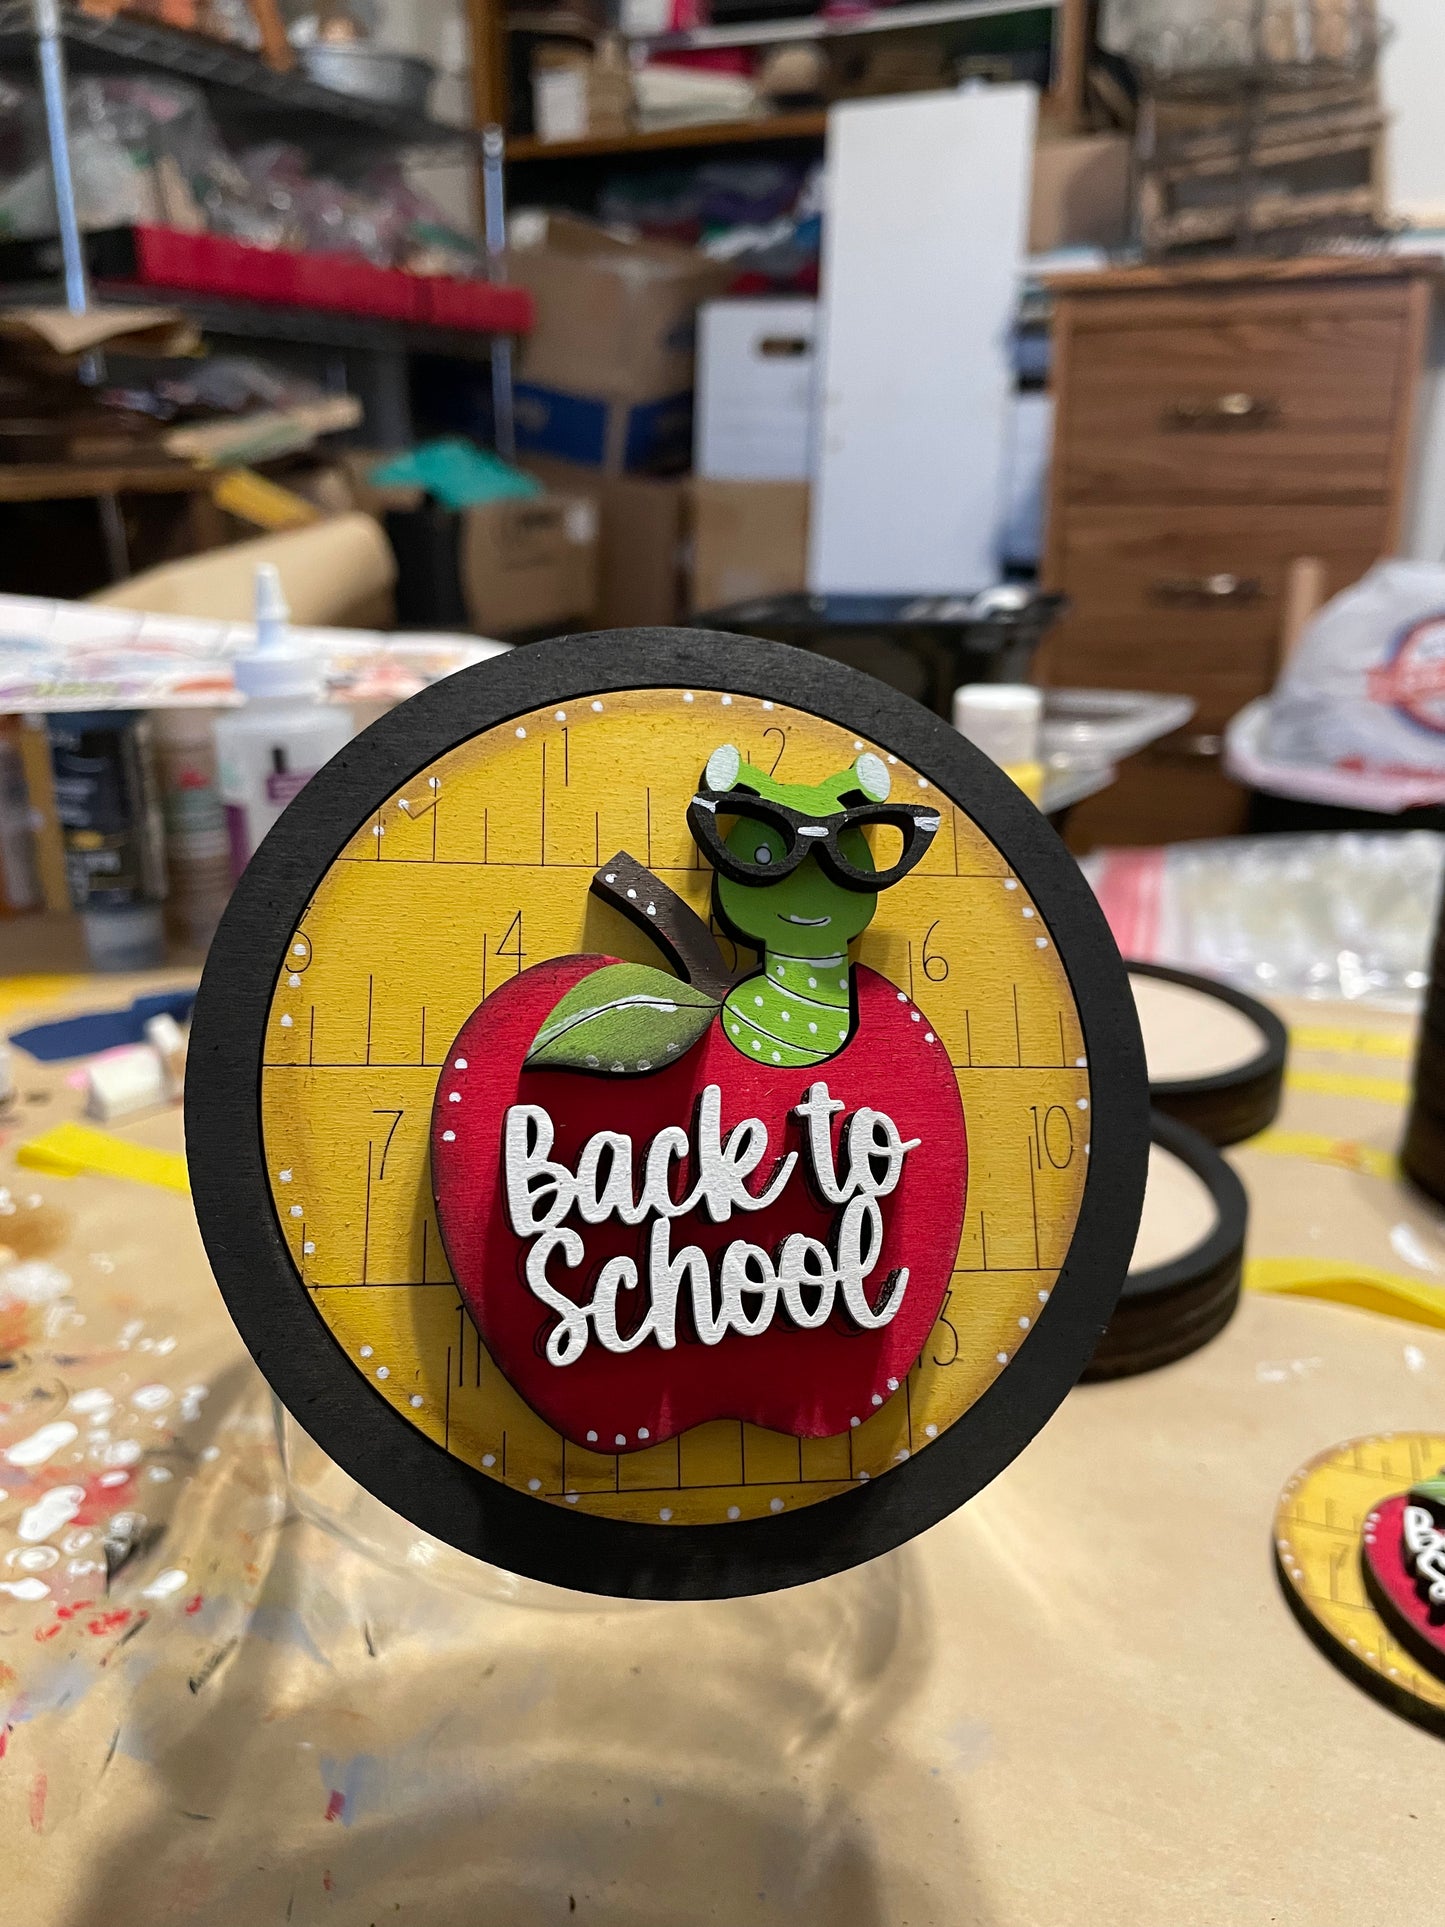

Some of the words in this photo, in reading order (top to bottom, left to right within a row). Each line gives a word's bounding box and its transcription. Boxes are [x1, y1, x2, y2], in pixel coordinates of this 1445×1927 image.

[561, 726, 569, 787] 1
[495, 910, 528, 974] 4
[922, 920, 949, 982] 6
[372, 1109, 404, 1181] 7
[505, 1083, 799, 1238] Back
[794, 1081, 922, 1205] to
[1029, 1105, 1074, 1170] 10
[525, 1193, 911, 1368] School
